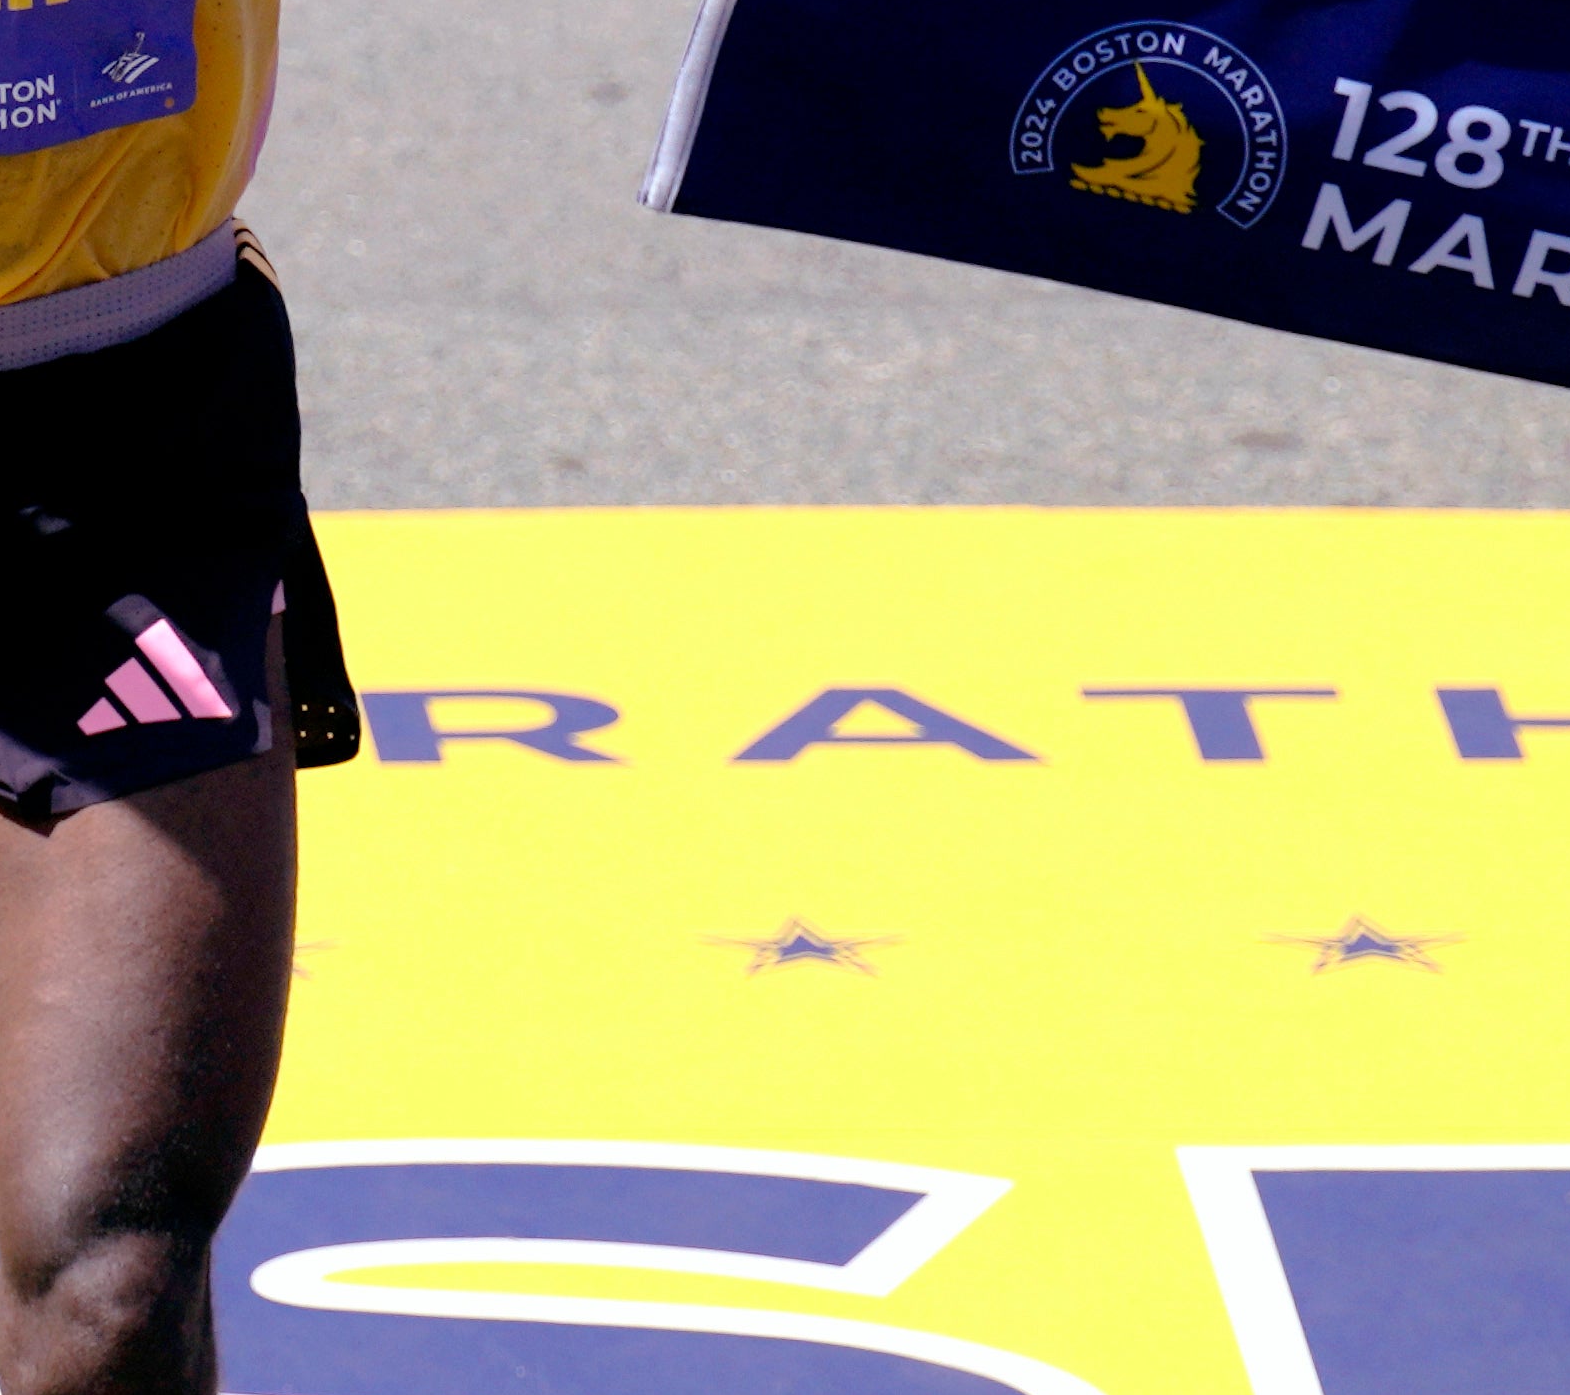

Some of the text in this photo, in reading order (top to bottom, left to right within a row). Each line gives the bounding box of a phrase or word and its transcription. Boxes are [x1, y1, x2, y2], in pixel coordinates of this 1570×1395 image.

[1020, 31, 1277, 212] 2024 BOSTON MARATHON
